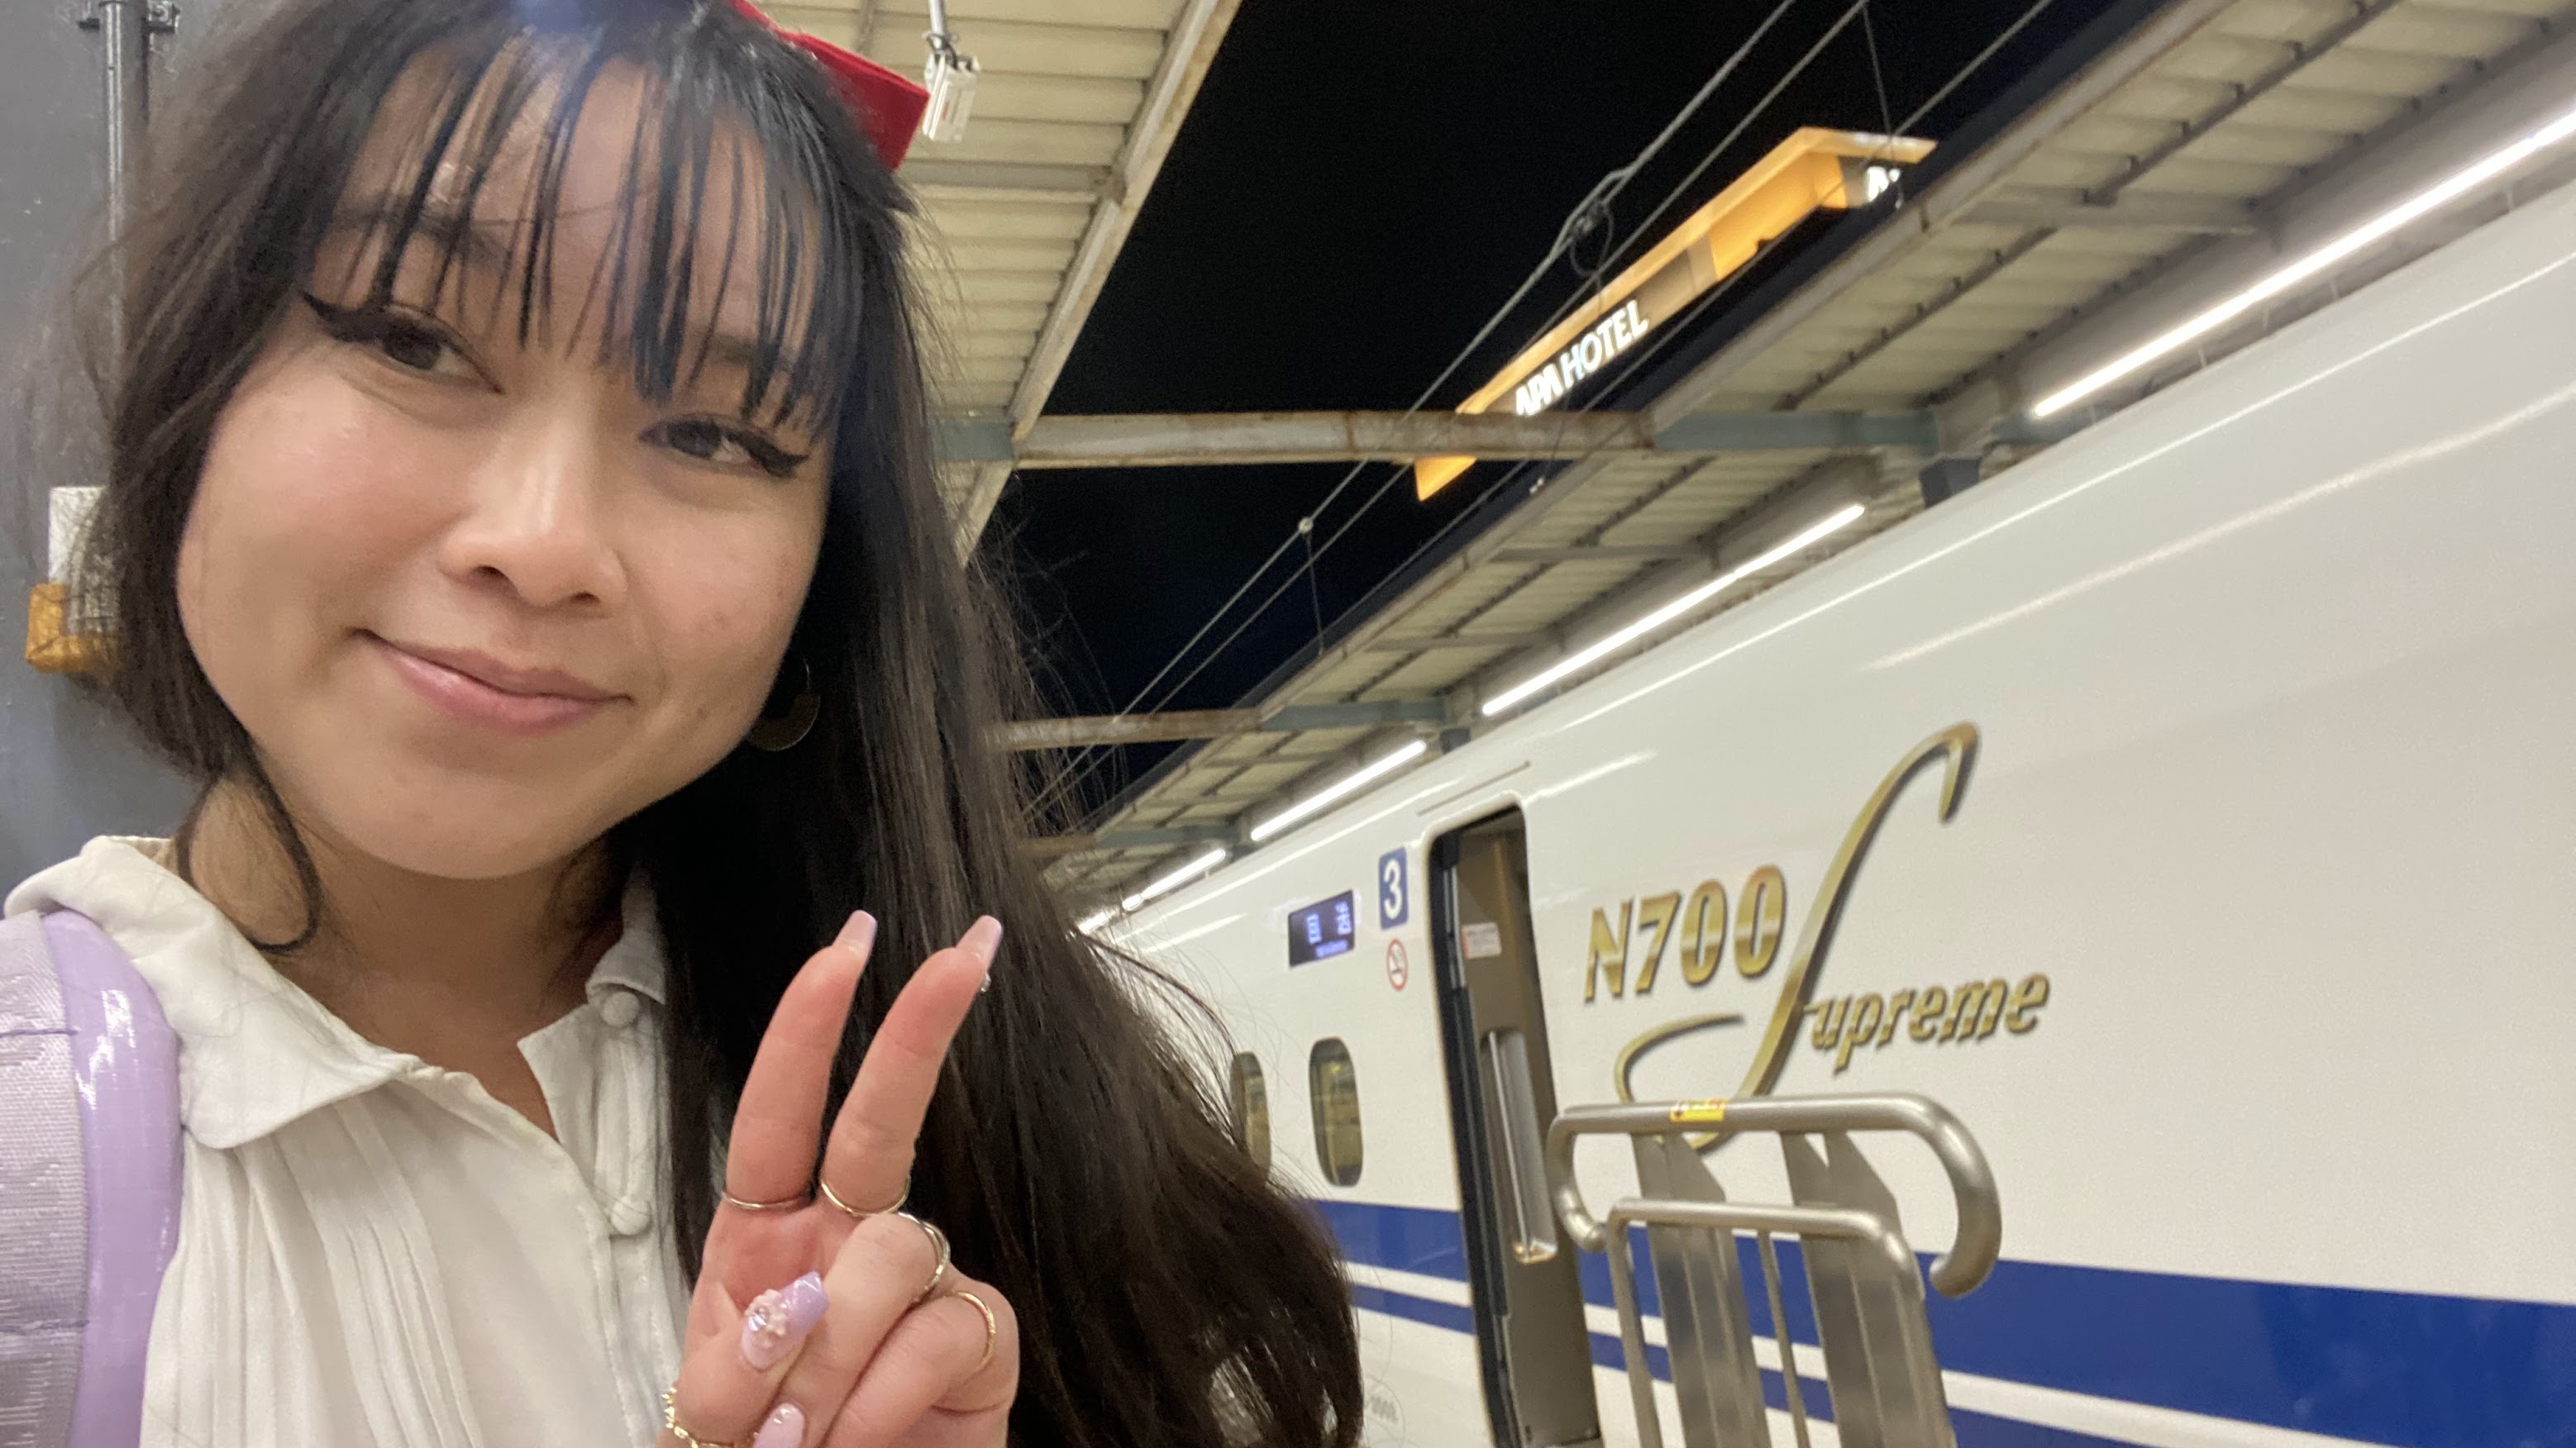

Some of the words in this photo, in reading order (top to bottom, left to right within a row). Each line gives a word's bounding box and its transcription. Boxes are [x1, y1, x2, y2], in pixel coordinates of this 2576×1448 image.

[1515, 364, 1563, 416] APA
[1560, 300, 1648, 389] HOTEL
[1385, 859, 1402, 919] 3
[1583, 864, 1787, 1006] N700
